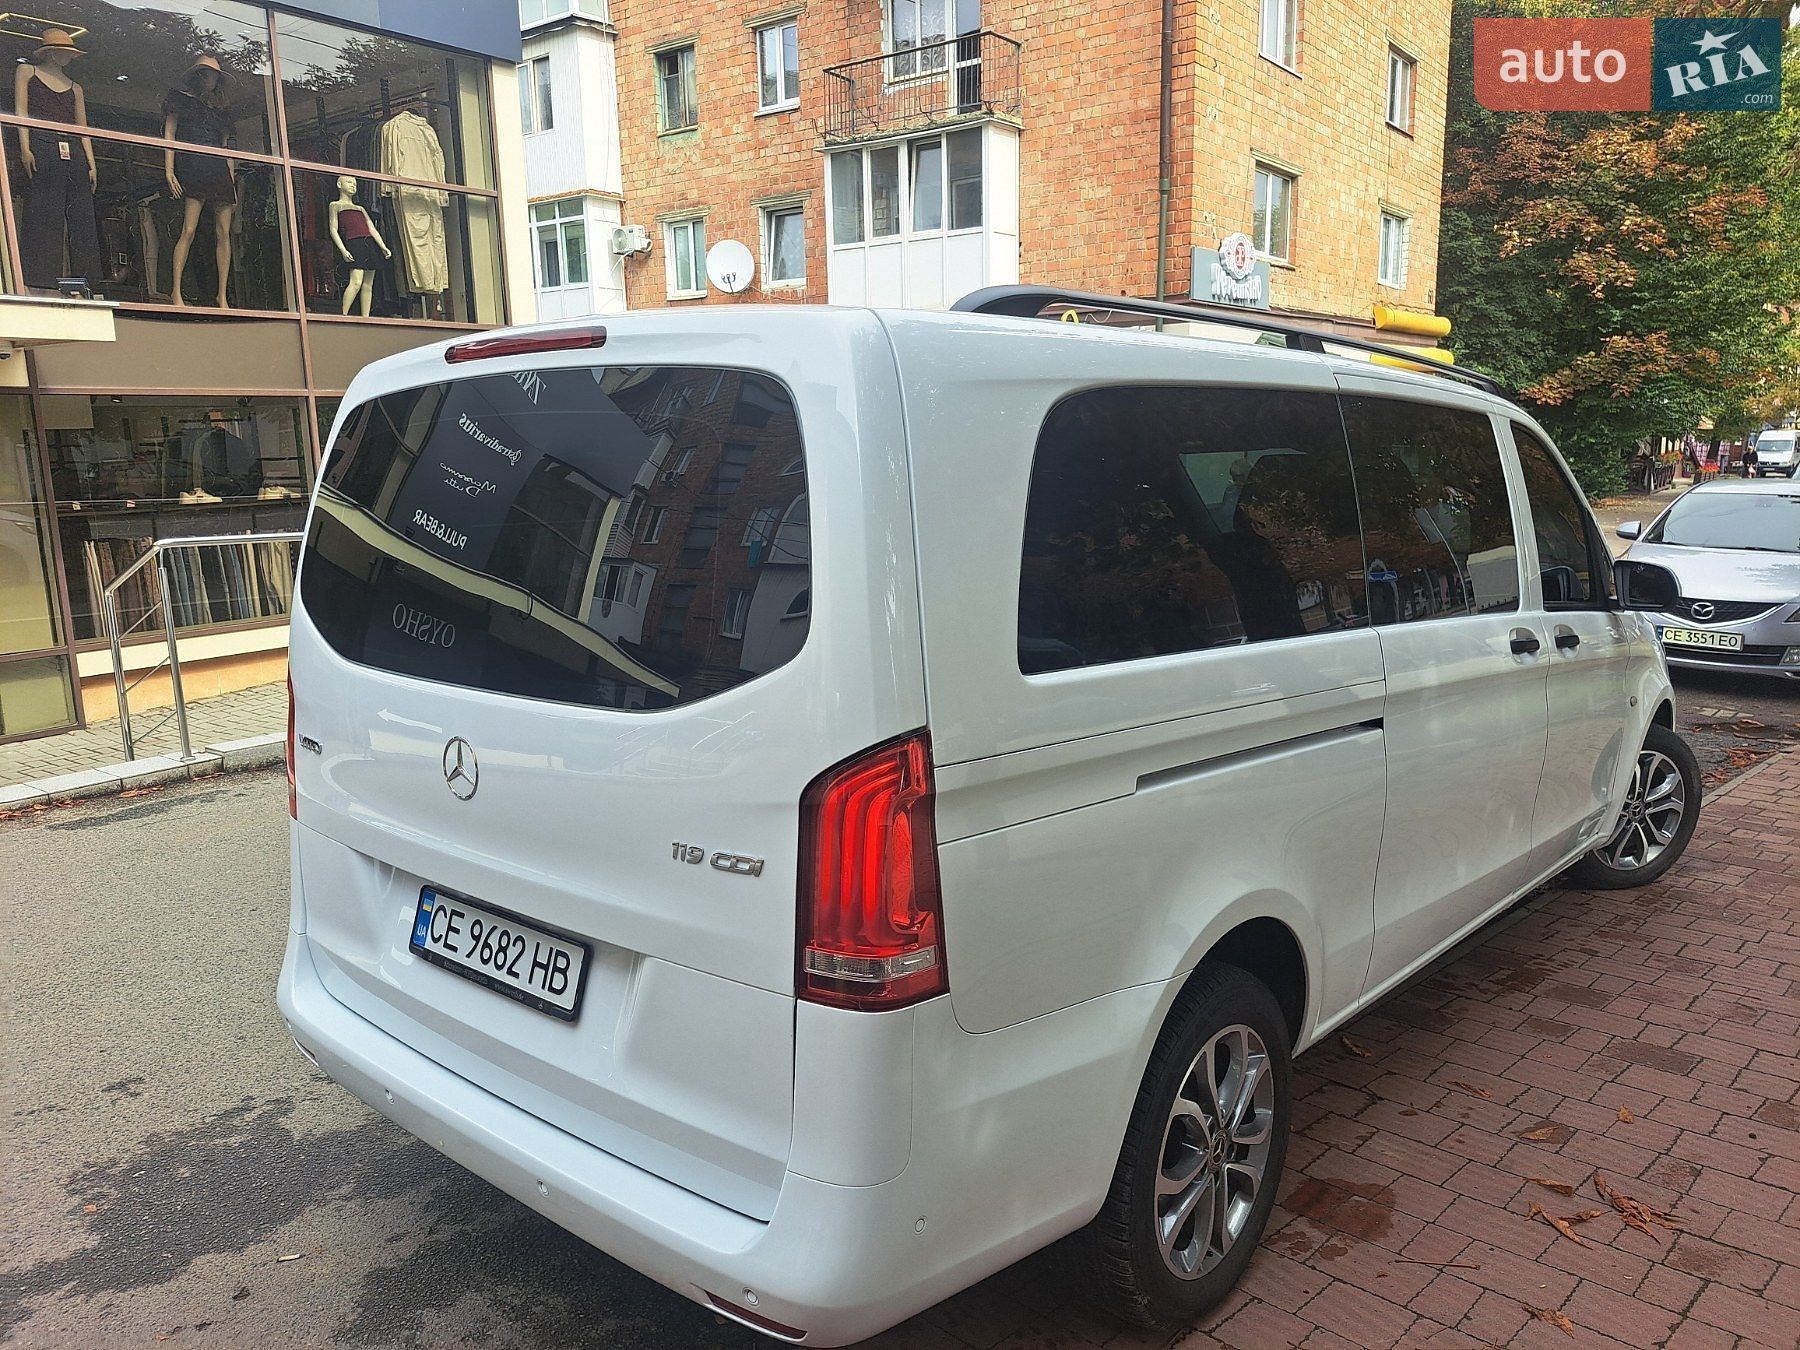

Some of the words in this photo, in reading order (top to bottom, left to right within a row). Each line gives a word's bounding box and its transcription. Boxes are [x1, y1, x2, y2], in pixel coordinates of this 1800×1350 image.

[1664, 629, 1683, 642] CE
[1685, 631, 1715, 646] 3551
[1718, 634, 1738, 647] EO
[671, 842, 705, 864] 119
[709, 852, 765, 877] CDI
[417, 924, 426, 937] UA
[430, 904, 465, 953] CE
[465, 919, 526, 979] 9682
[527, 941, 571, 996] HB
